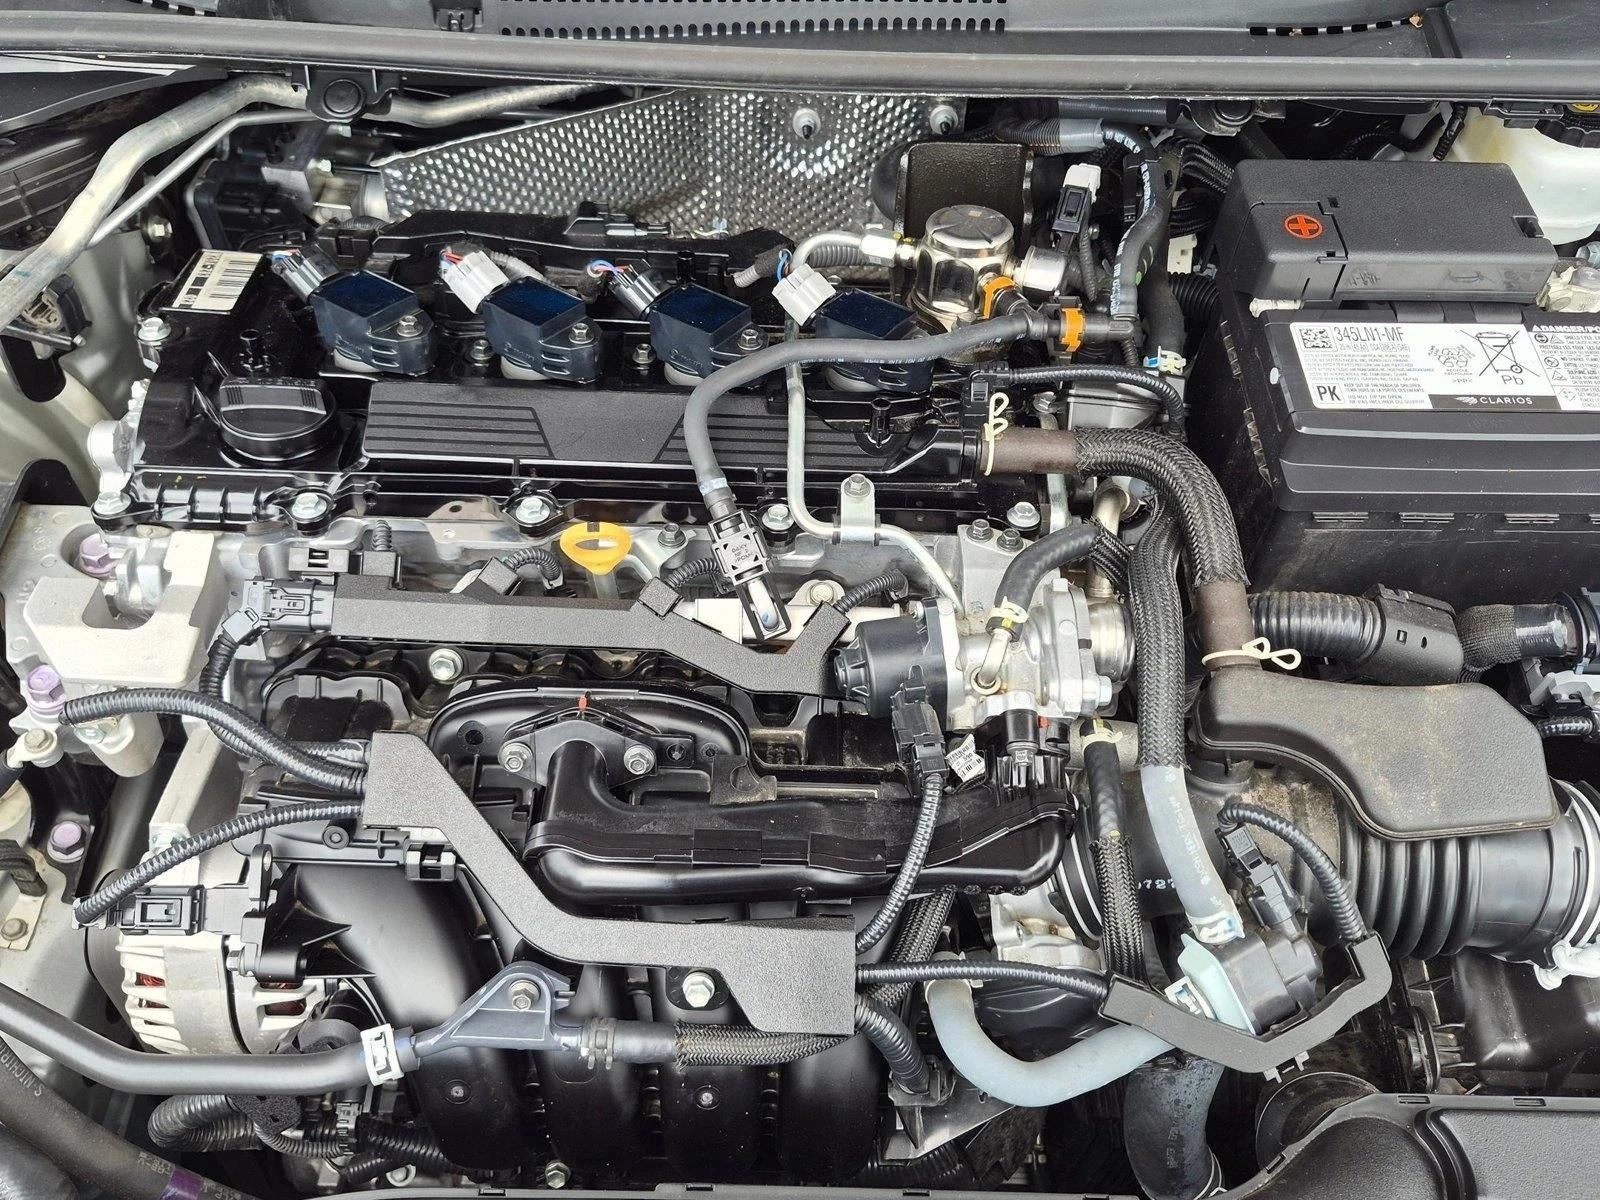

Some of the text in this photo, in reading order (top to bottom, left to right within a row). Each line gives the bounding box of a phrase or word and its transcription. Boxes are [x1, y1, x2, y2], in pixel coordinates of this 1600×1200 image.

[1334, 326, 1404, 342] 345LN1-MF
[1502, 375, 1524, 385] Pb
[1317, 385, 1341, 401] PK
[1480, 396, 1533, 405] CLARIOS
